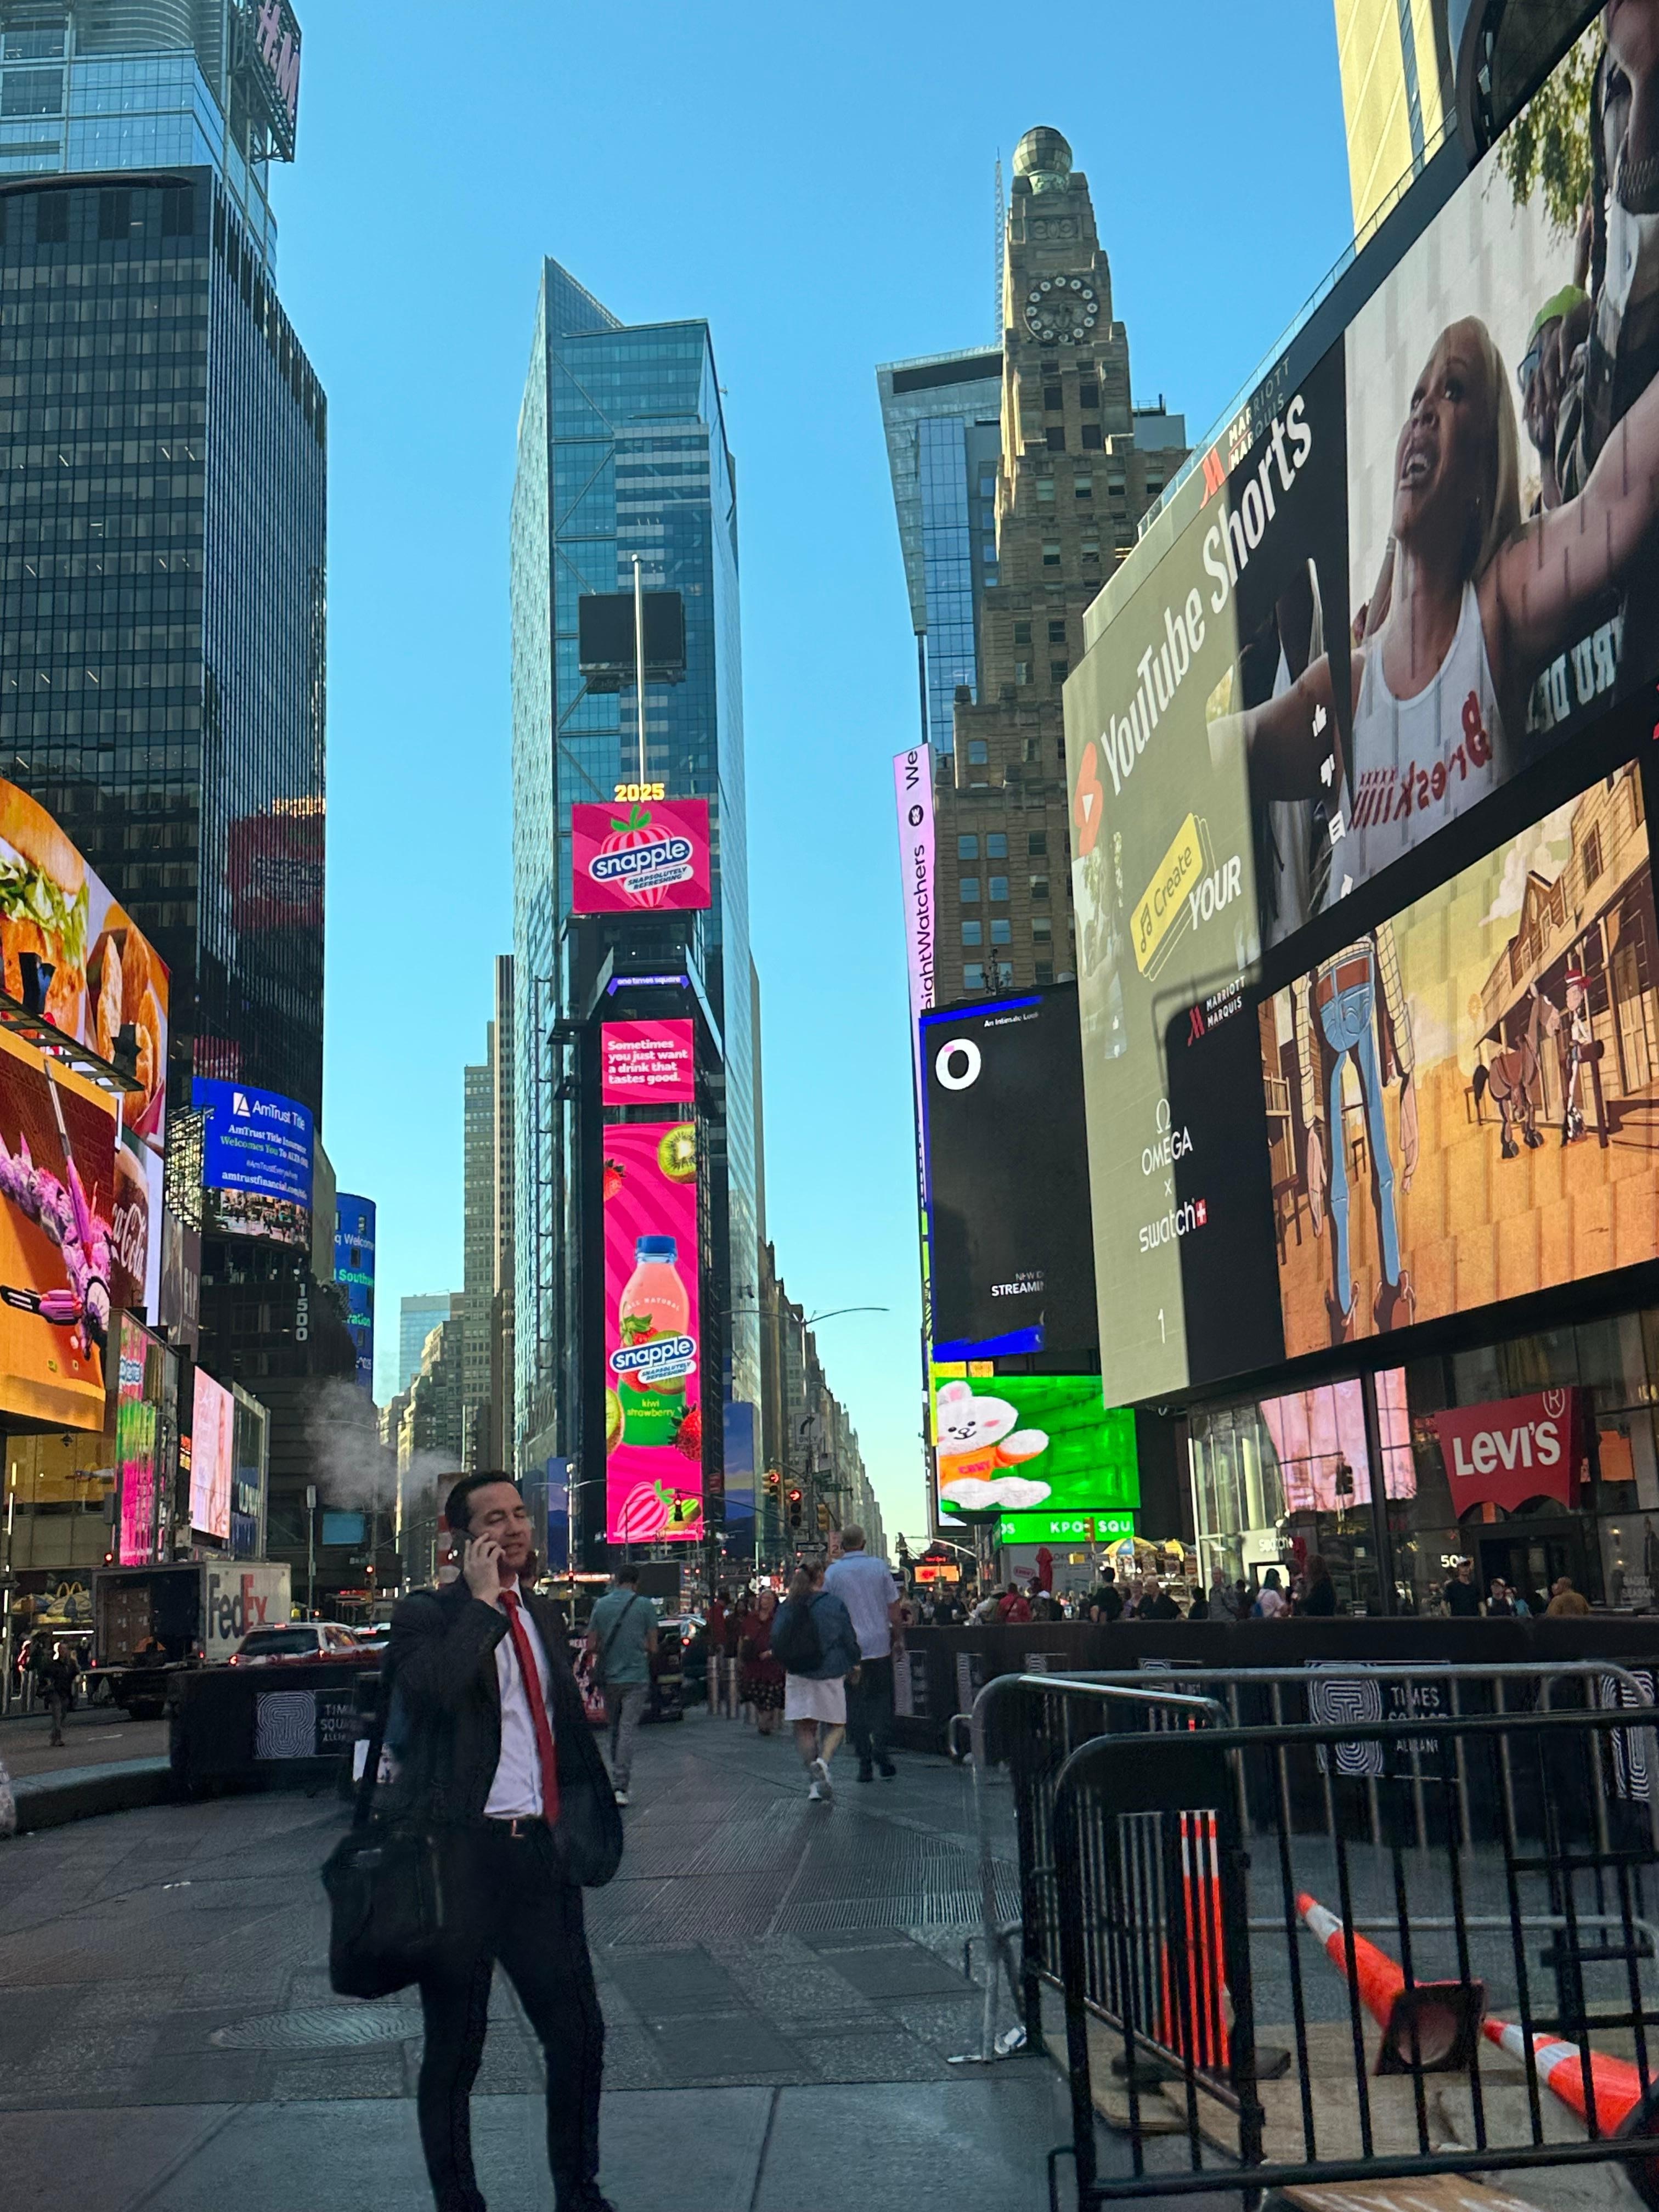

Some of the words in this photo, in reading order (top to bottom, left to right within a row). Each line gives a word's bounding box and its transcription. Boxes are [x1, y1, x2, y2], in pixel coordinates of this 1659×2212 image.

[1229, 357, 1290, 447] MARRIOTT
[1231, 392, 1284, 471] MARQUIS
[1100, 588, 1206, 795] YouTube
[1203, 394, 1312, 614] Shorts
[905, 750, 919, 791] We
[614, 783, 665, 802] 2025
[596, 839, 686, 876] snapple
[628, 866, 687, 885] SNAPSOLUTELY
[633, 873, 682, 890] REFRESHING
[1154, 847, 1192, 918] Create
[1189, 855, 1242, 931] YOUR
[654, 977, 681, 985] square
[1206, 975, 1245, 1012] MARRIOTT
[1207, 996, 1242, 1028] MARQUIS
[607, 1039, 674, 1051] Sometimes
[608, 1053, 631, 1064] you
[632, 1050, 656, 1063] just
[657, 1049, 689, 1059] want
[608, 1065, 616, 1074] a
[618, 1062, 650, 1073] drink
[651, 1062, 678, 1071] that
[608, 1074, 645, 1084] tastes
[646, 1071, 681, 1085] good.
[252, 1101, 291, 1125] AmTrust
[228, 1125, 265, 1139] AmTrust
[220, 1136, 264, 1152] Welcomes
[1141, 1126, 1193, 1176] OMEGA
[1138, 1201, 1197, 1253] swatch
[295, 1283, 308, 1341] 1500
[644, 1297, 681, 1311] NATURAL
[616, 1336, 691, 1368] snapple
[627, 1407, 675, 1418] strawberry
[641, 1399, 660, 1408] kiwi
[1098, 1520, 1134, 1533] SQU
[208, 1573, 268, 1639] FedEx
[325, 1704, 347, 1715] TIM
[320, 1718, 343, 1731] SQU
